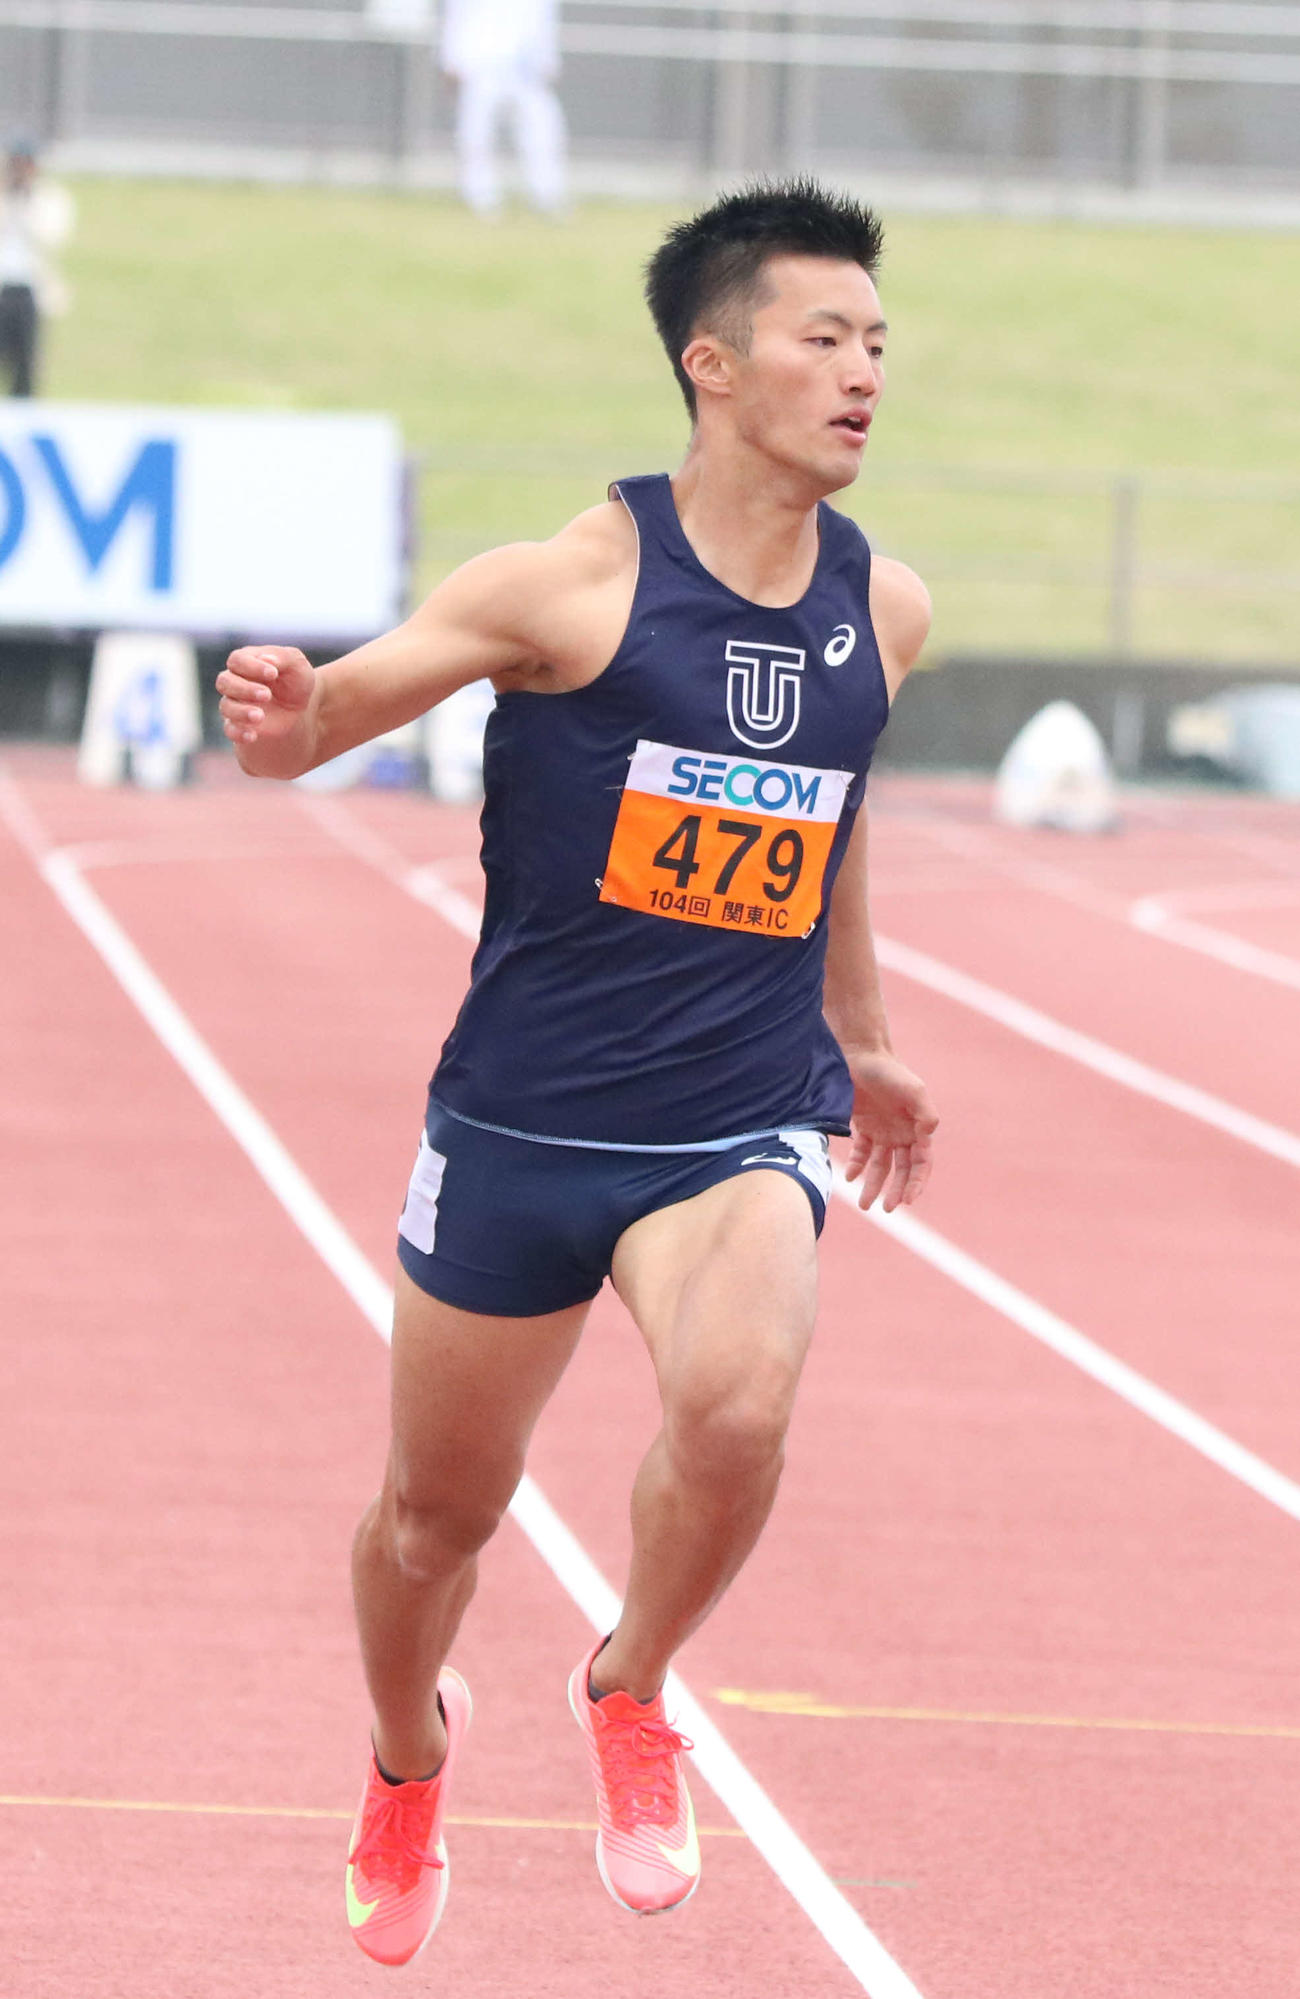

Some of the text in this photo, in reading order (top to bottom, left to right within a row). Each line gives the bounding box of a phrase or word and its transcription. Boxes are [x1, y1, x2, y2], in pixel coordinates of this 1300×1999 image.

[0, 434, 175, 592] M
[667, 756, 822, 814] SECOM
[653, 815, 804, 902] 479
[649, 889, 789, 930] 104回 関東IC
